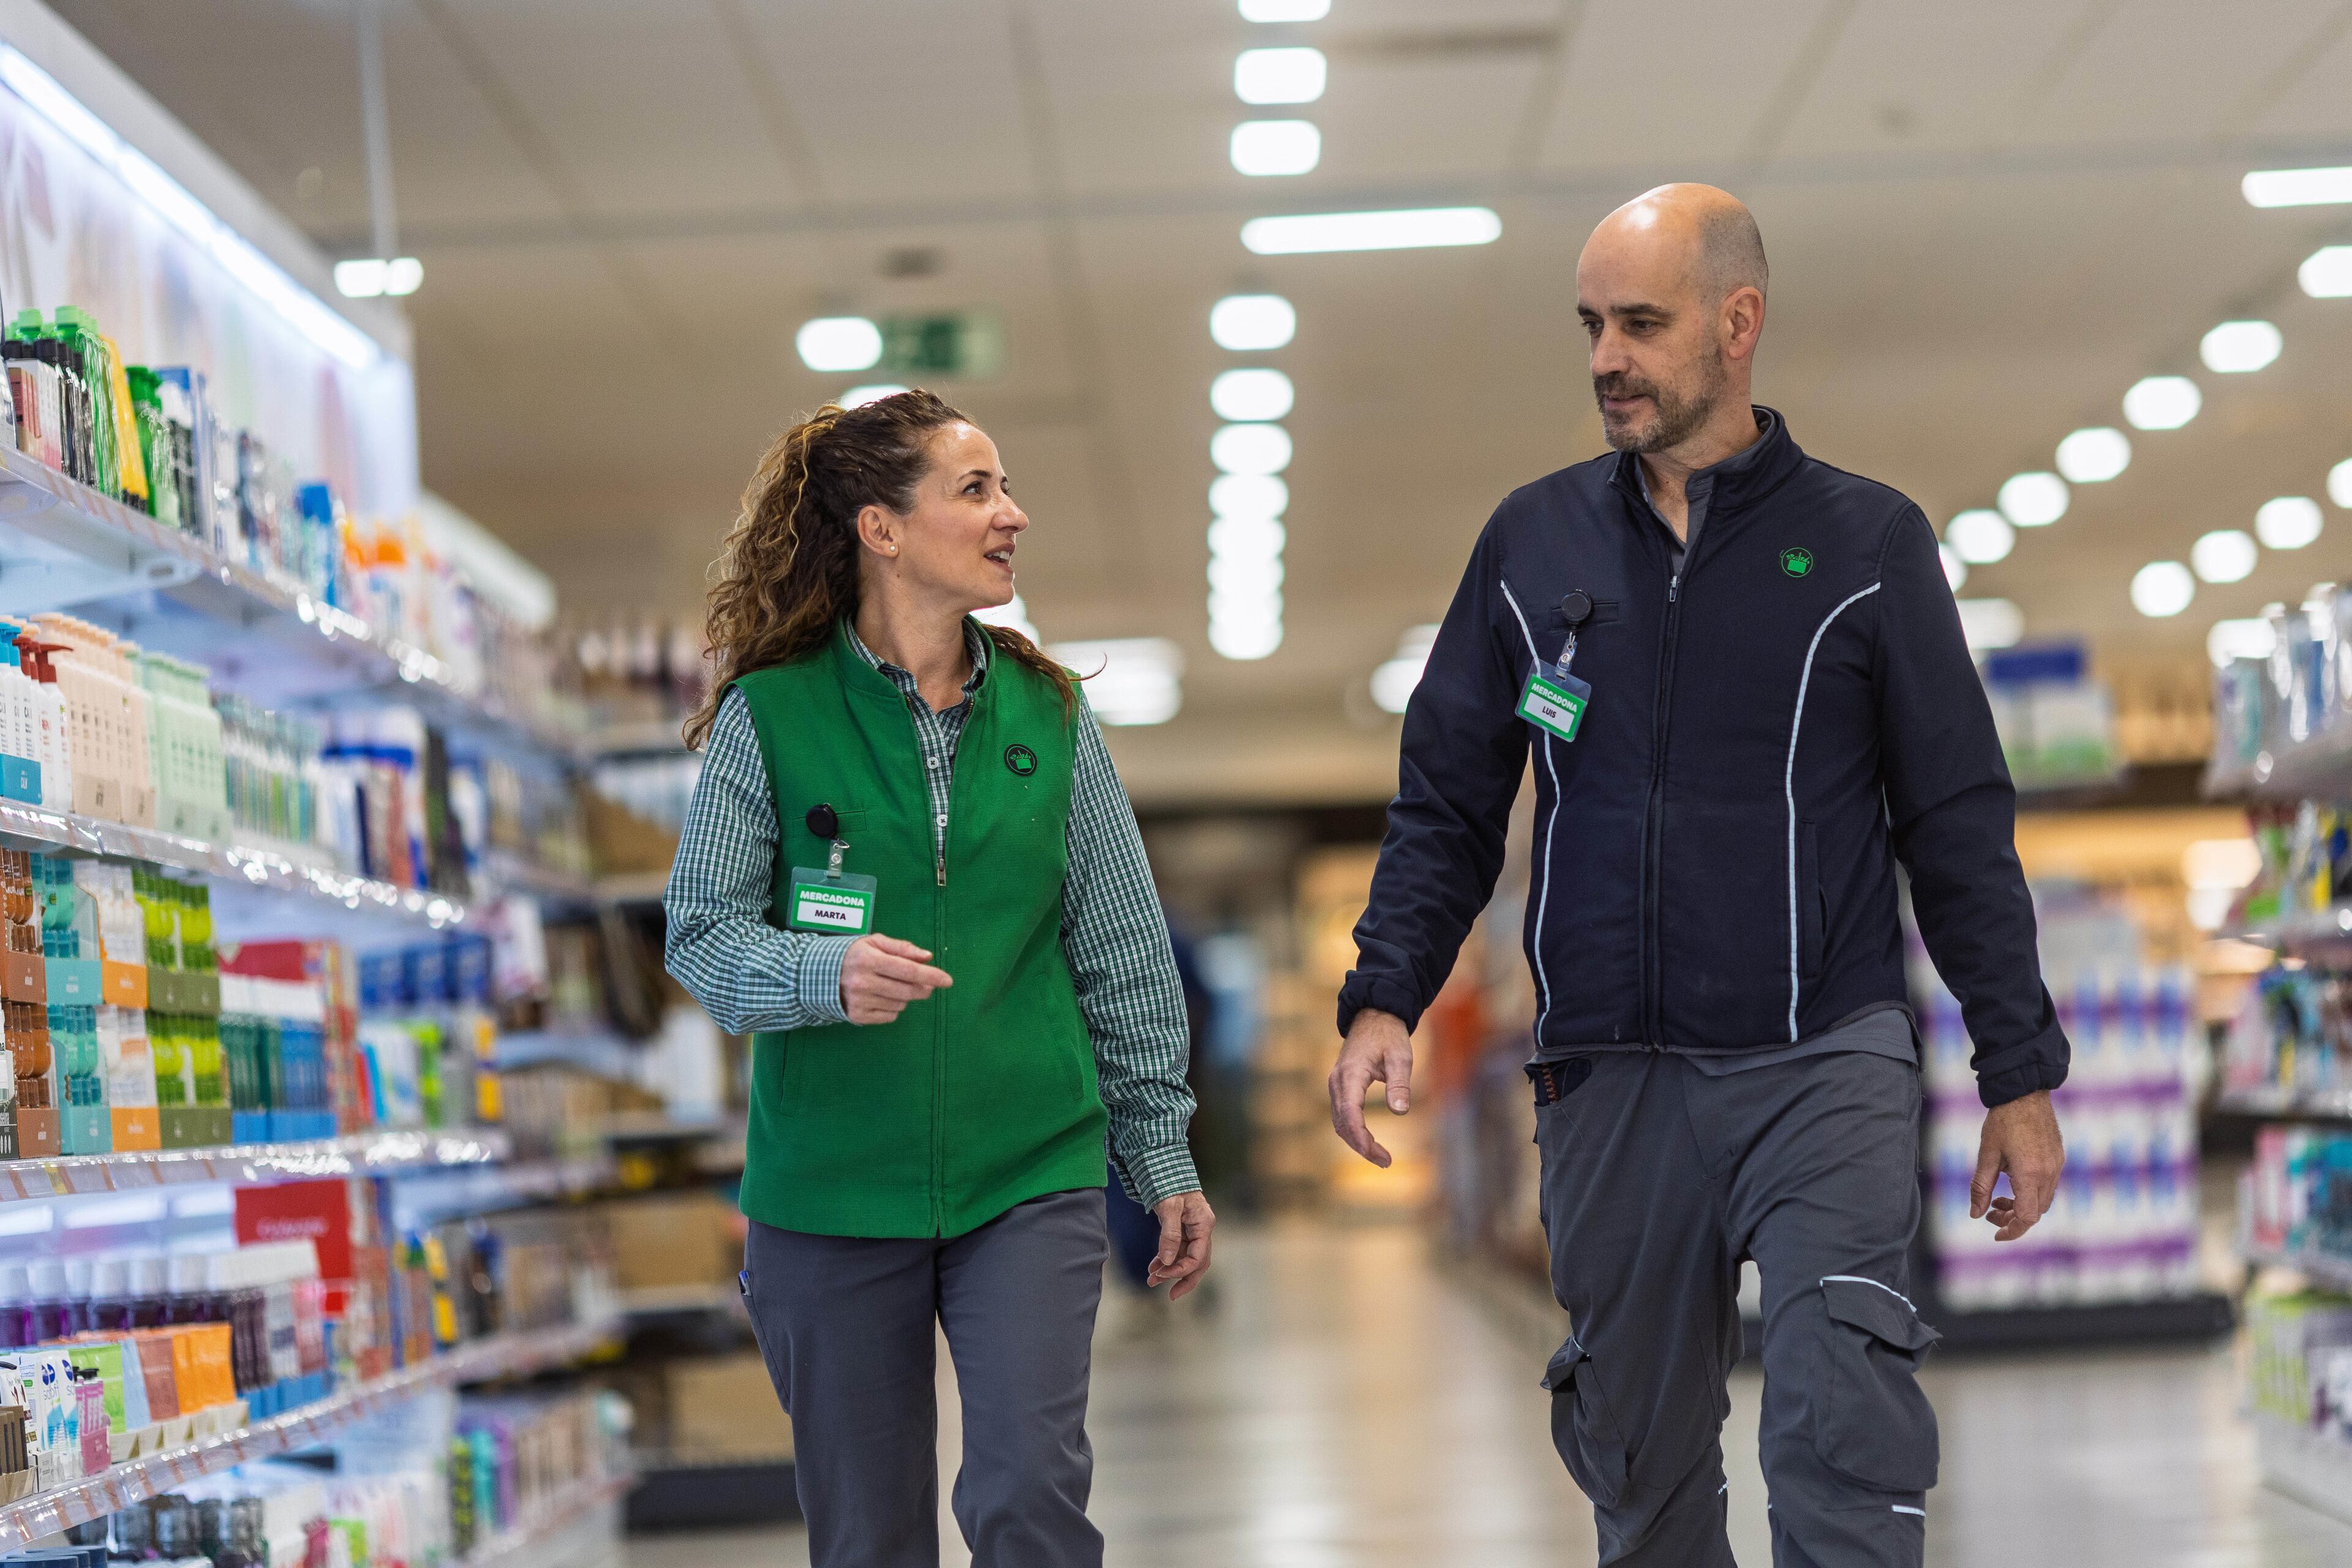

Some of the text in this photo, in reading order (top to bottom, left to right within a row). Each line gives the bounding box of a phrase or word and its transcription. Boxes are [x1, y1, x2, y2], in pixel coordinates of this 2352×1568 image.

[1532, 683, 1577, 712] MERCADONA
[1542, 706, 1556, 718] LUIS
[800, 891, 864, 907] MERCADONA
[815, 910, 846, 921] MARTA
